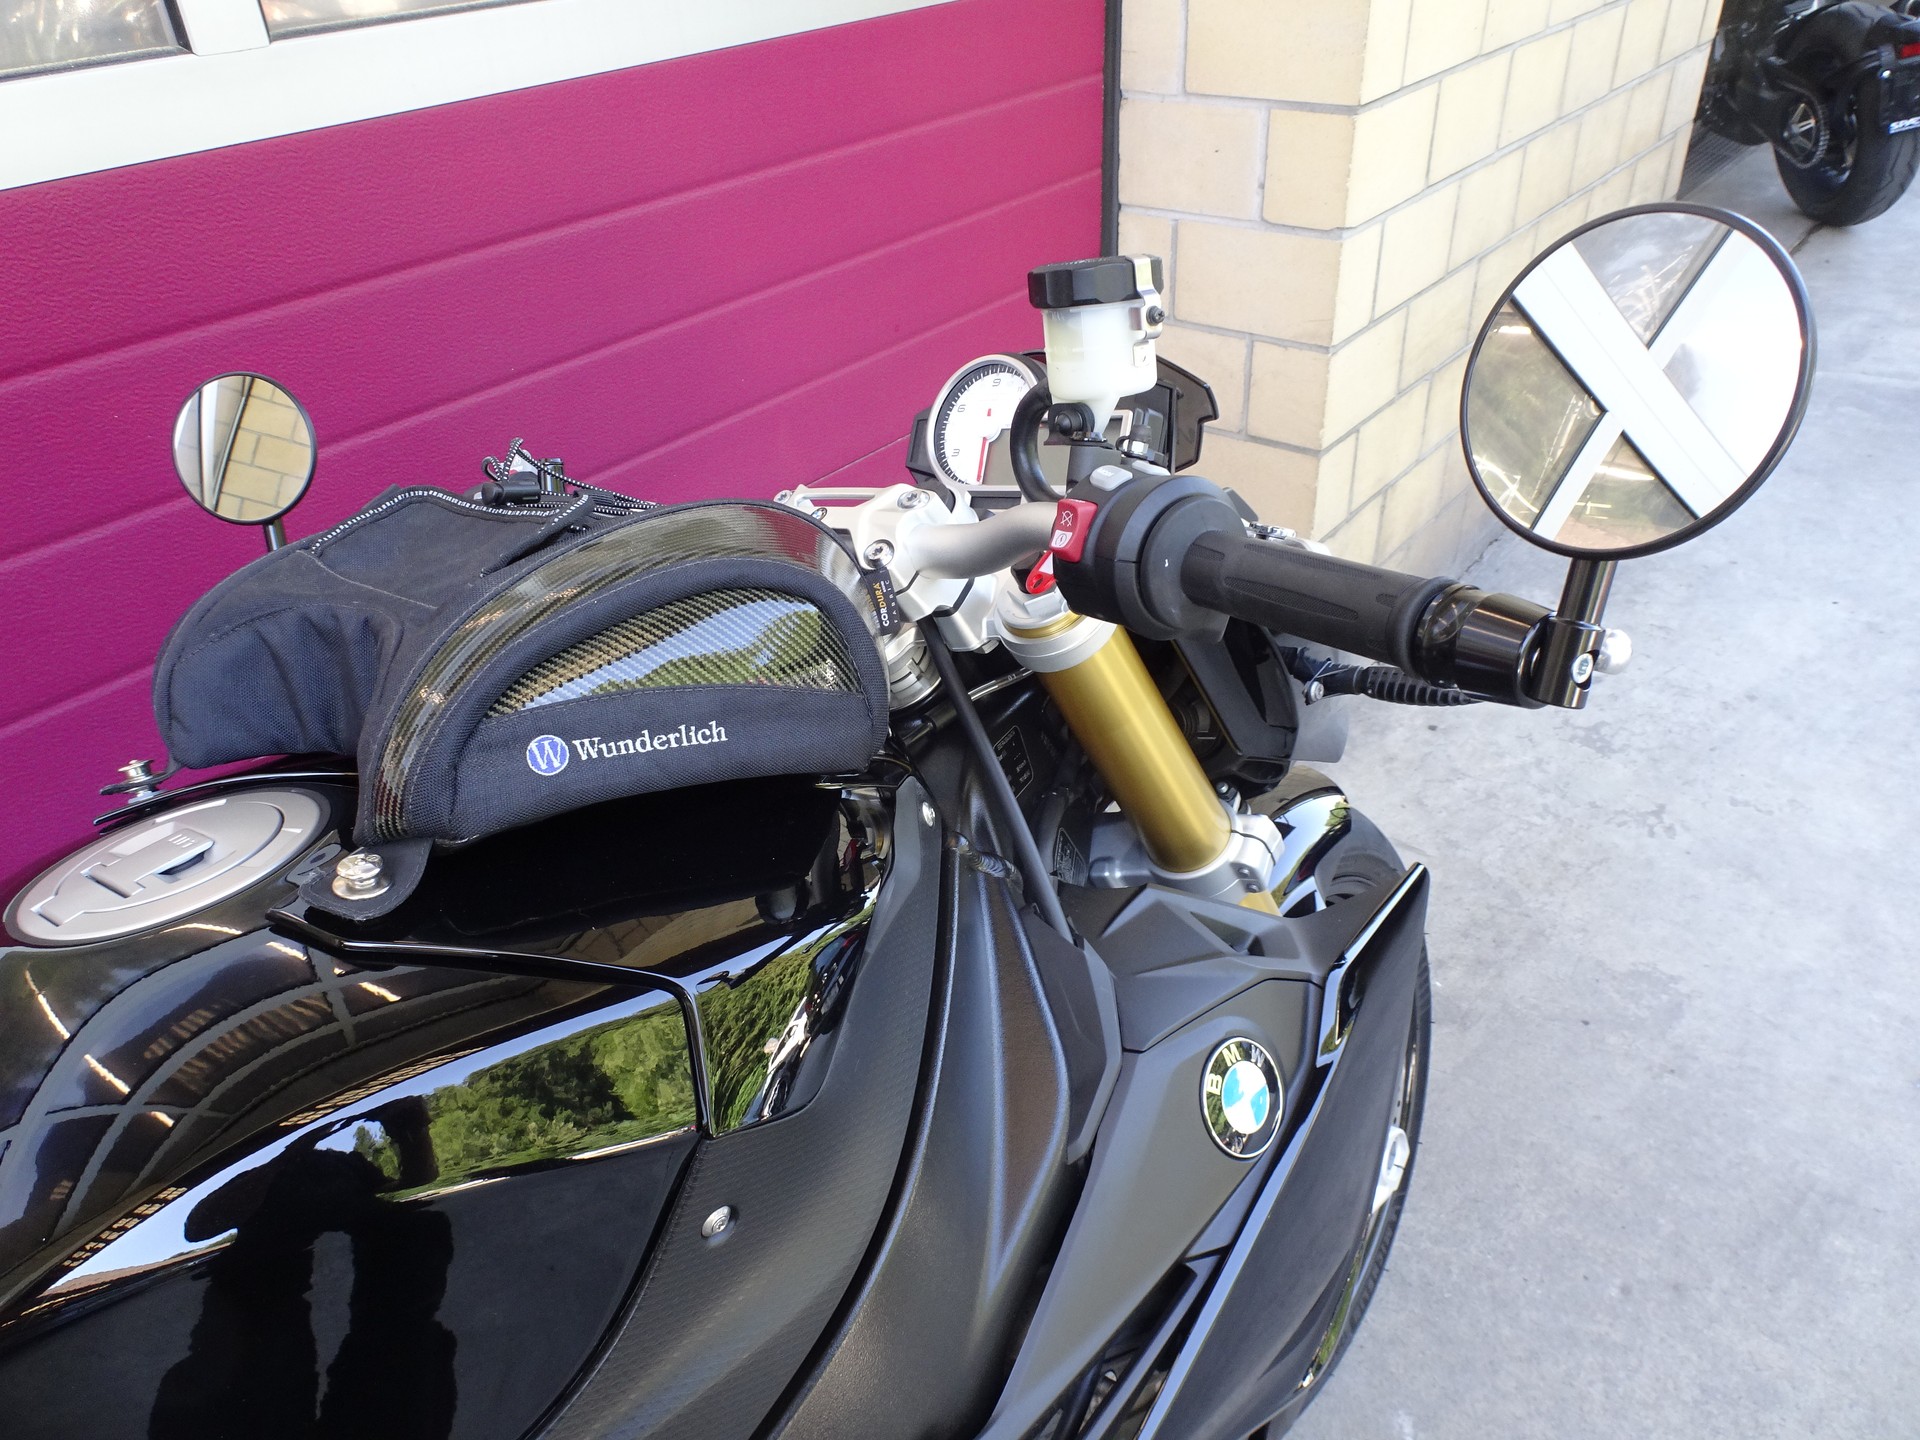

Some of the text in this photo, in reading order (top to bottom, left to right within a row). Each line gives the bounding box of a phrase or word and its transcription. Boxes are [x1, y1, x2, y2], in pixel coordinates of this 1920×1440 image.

[992, 378, 1001, 387] 9
[957, 403, 966, 412] 6
[951, 448, 960, 457] 3
[873, 582, 890, 627] CORDURA
[572, 720, 728, 761] Wunderlich
[1206, 1043, 1266, 1096] BMW
